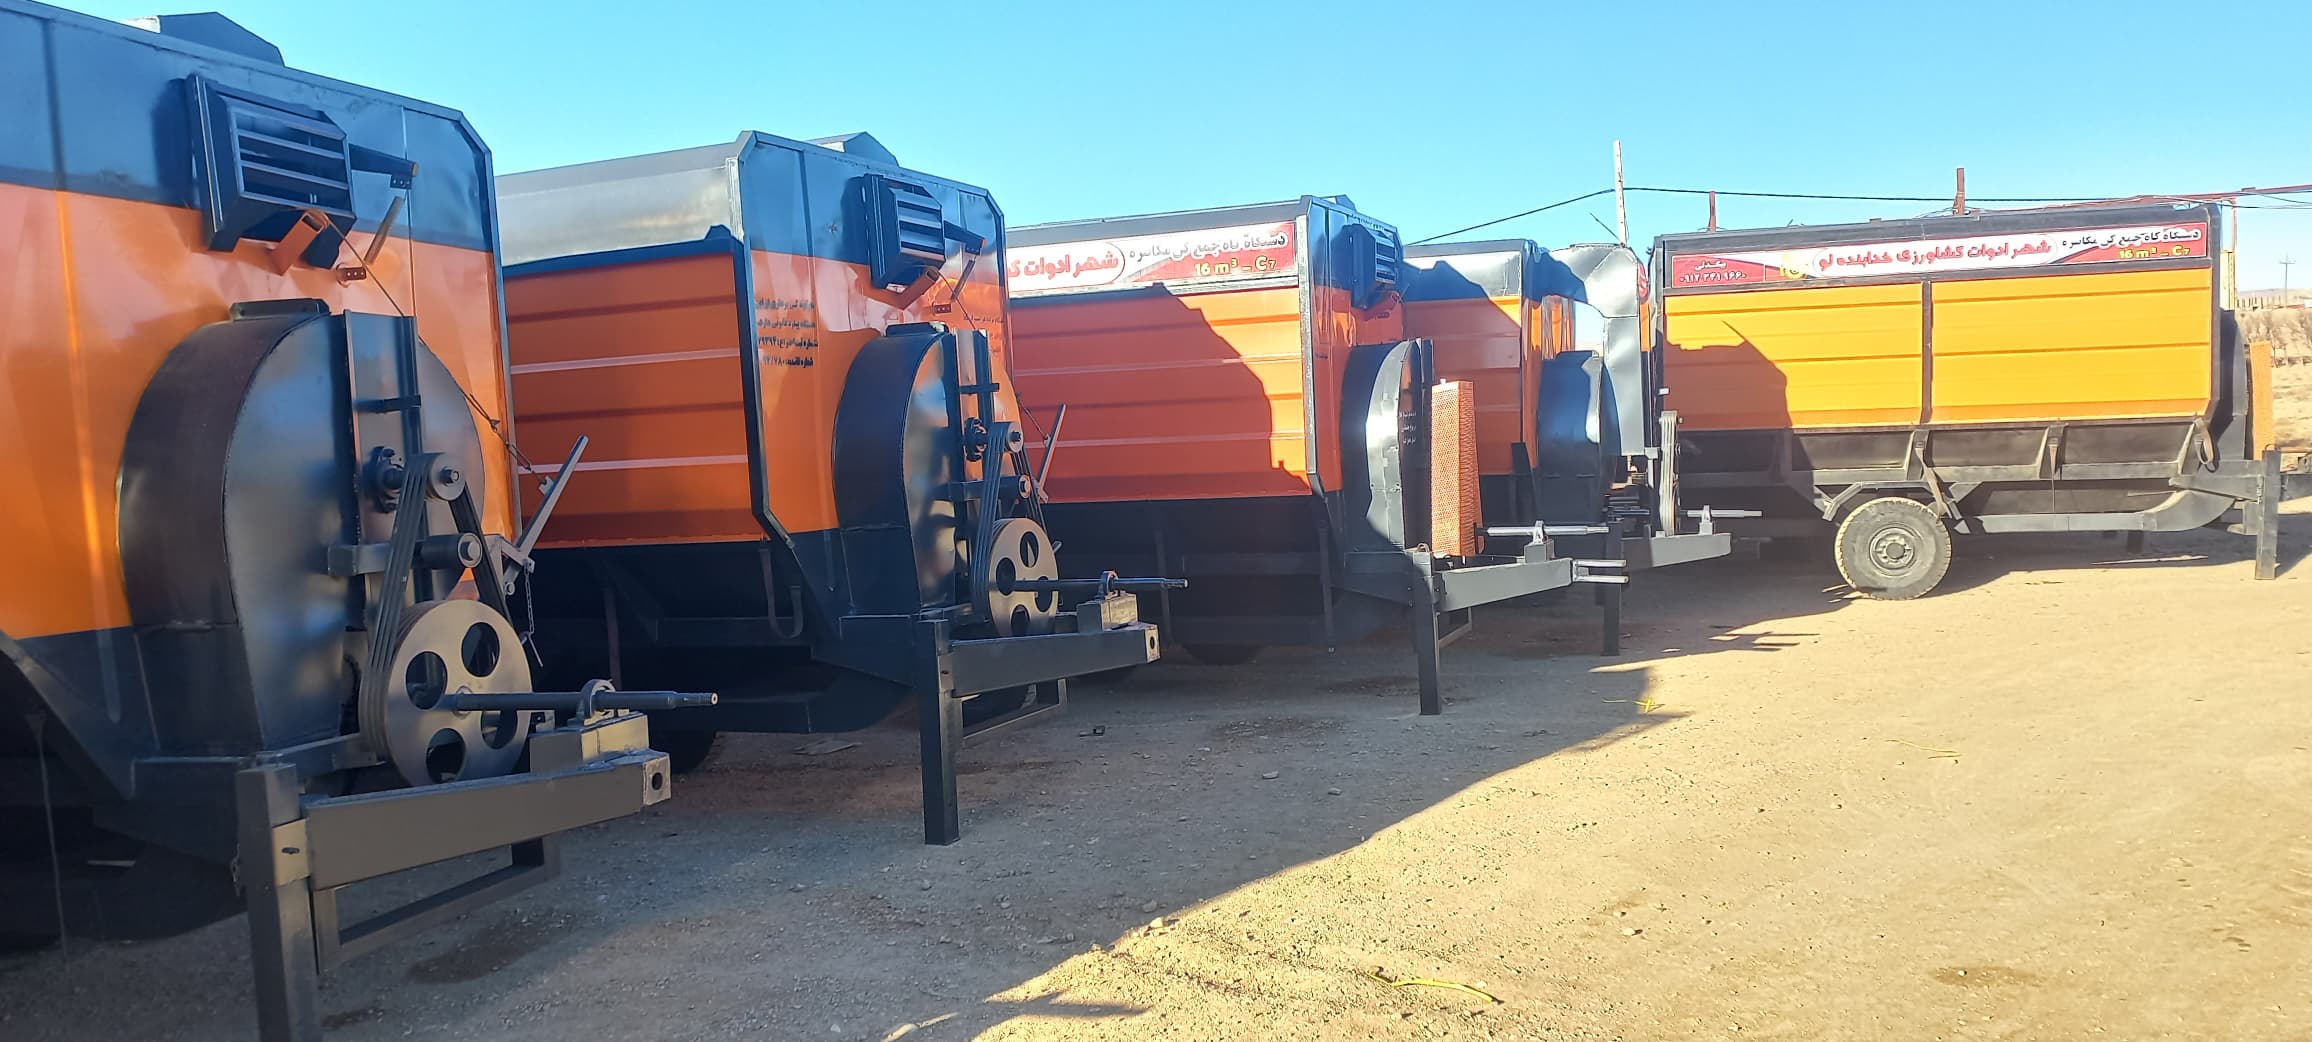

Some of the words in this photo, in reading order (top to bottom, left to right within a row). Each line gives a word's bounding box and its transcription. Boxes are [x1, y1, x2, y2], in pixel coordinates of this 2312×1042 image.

[1896, 245, 1965, 264] کشاورزی
[1967, 243, 2009, 260] ادوات
[2011, 240, 2052, 259] شهر
[2119, 249, 2134, 259] 16
[1023, 254, 1071, 280] ادوات
[1072, 251, 1119, 278] شهر
[1194, 262, 1210, 276] 16
